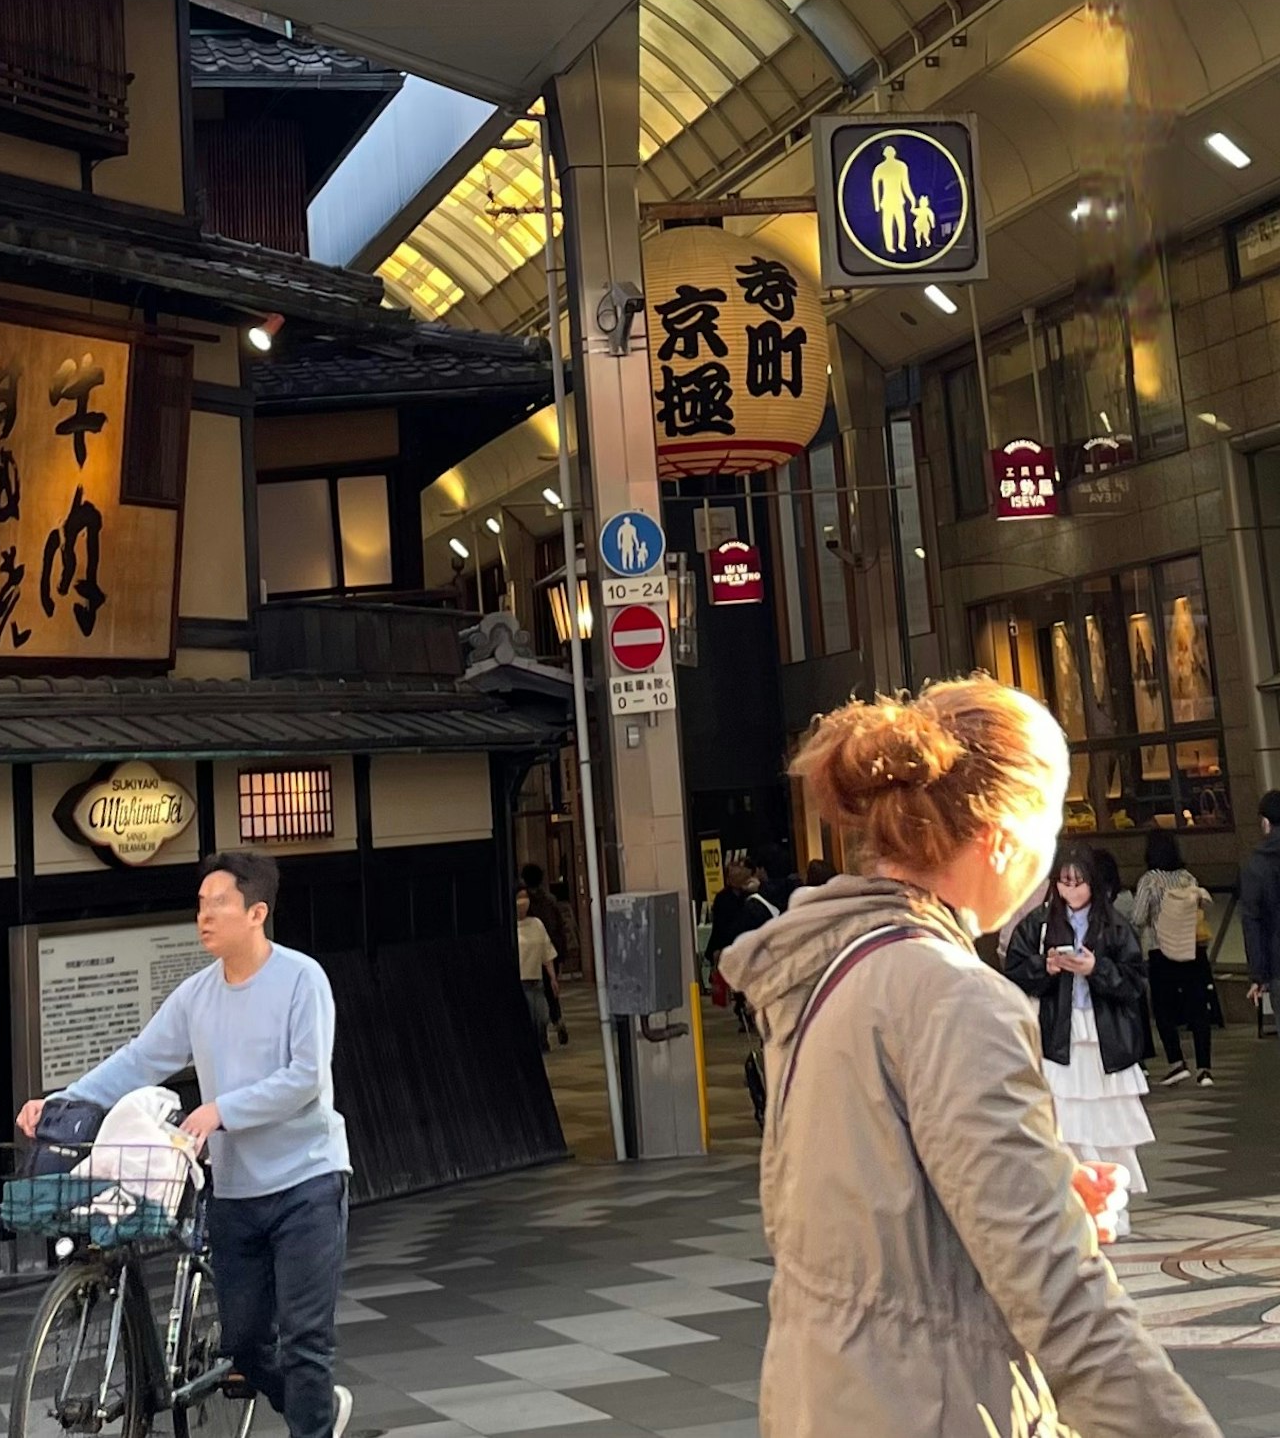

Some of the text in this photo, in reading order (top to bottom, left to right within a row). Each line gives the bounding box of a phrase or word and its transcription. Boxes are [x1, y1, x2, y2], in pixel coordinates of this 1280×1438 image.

[653, 284, 736, 438] 京極
[734, 255, 808, 399] 寺町
[40, 351, 108, 638] 牛肉
[1010, 495, 1046, 508] ISEYA
[111, 777, 159, 792] SUKIYAKI
